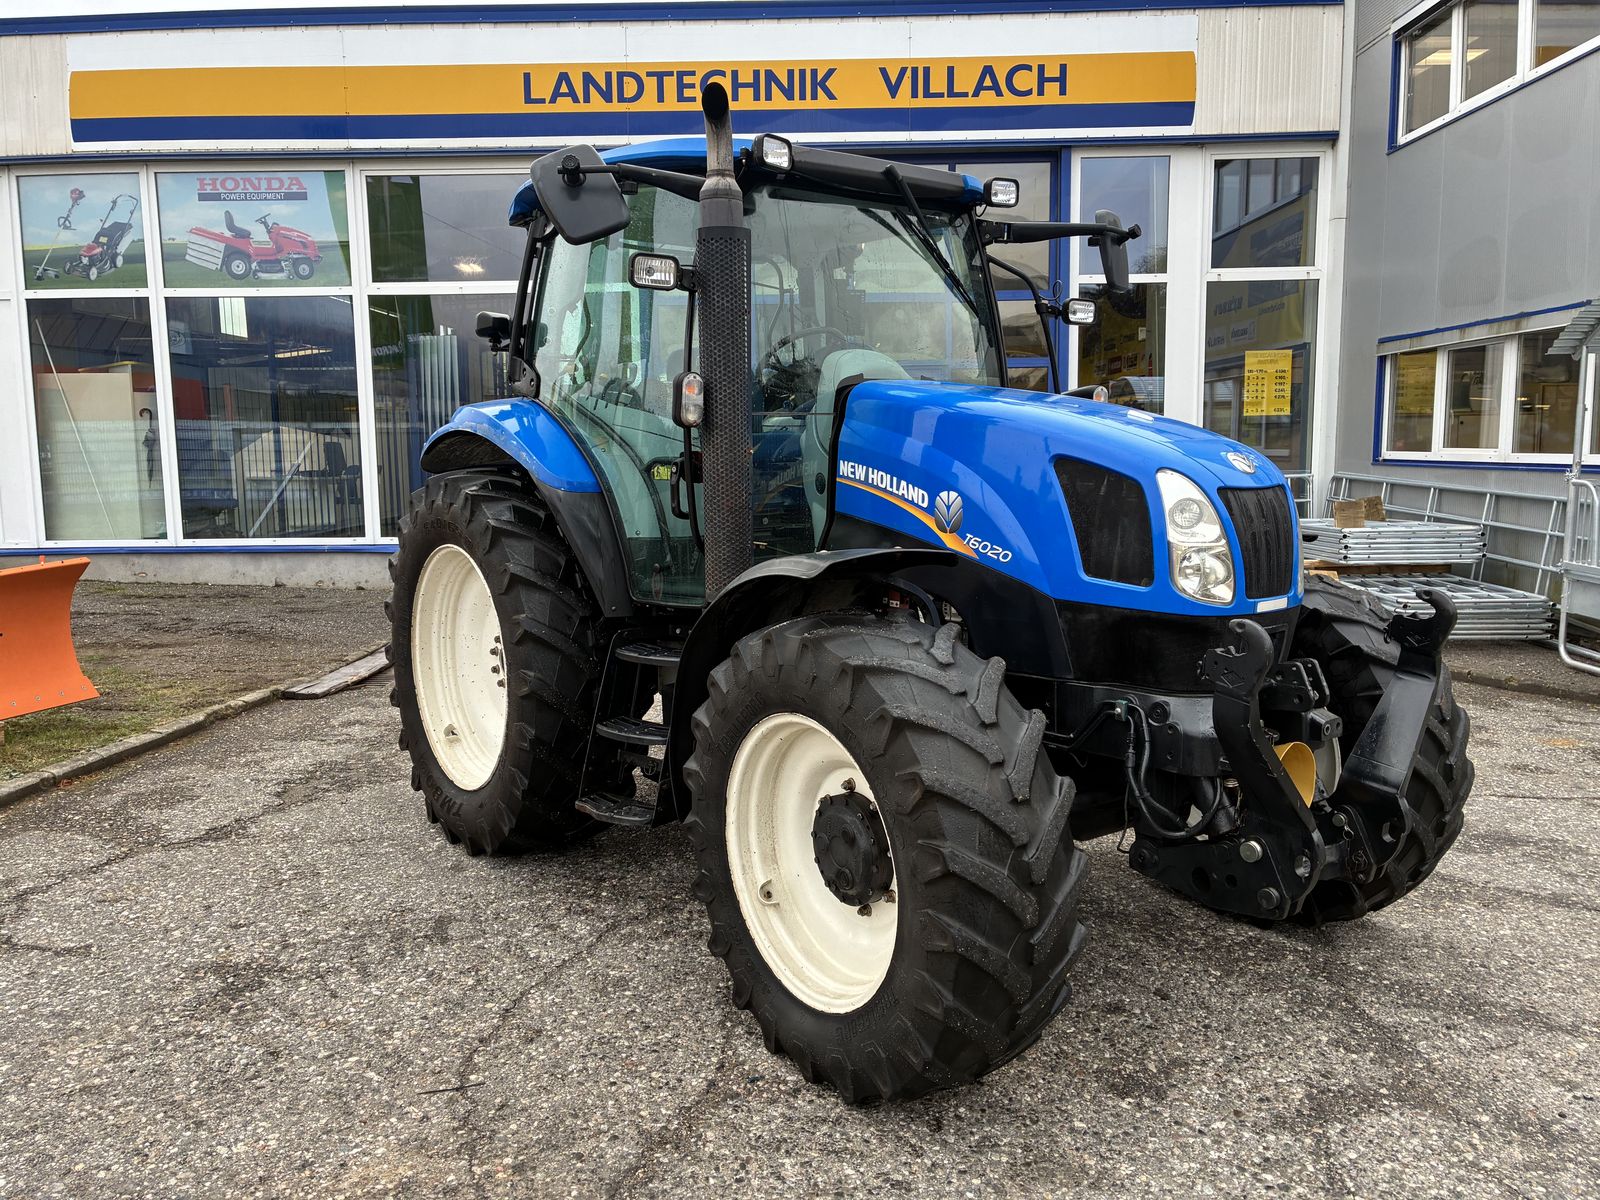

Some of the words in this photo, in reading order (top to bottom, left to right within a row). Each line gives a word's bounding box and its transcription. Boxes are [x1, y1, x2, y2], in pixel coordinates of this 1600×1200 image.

[522, 67, 838, 104] LANDTECHNIK
[878, 63, 1068, 99] VILLACH
[196, 176, 307, 192] HONDA
[246, 192, 285, 200] EQUIPMENT
[839, 460, 867, 481] NEW
[868, 467, 929, 509] HOLLAND
[963, 533, 1012, 563] T6020
